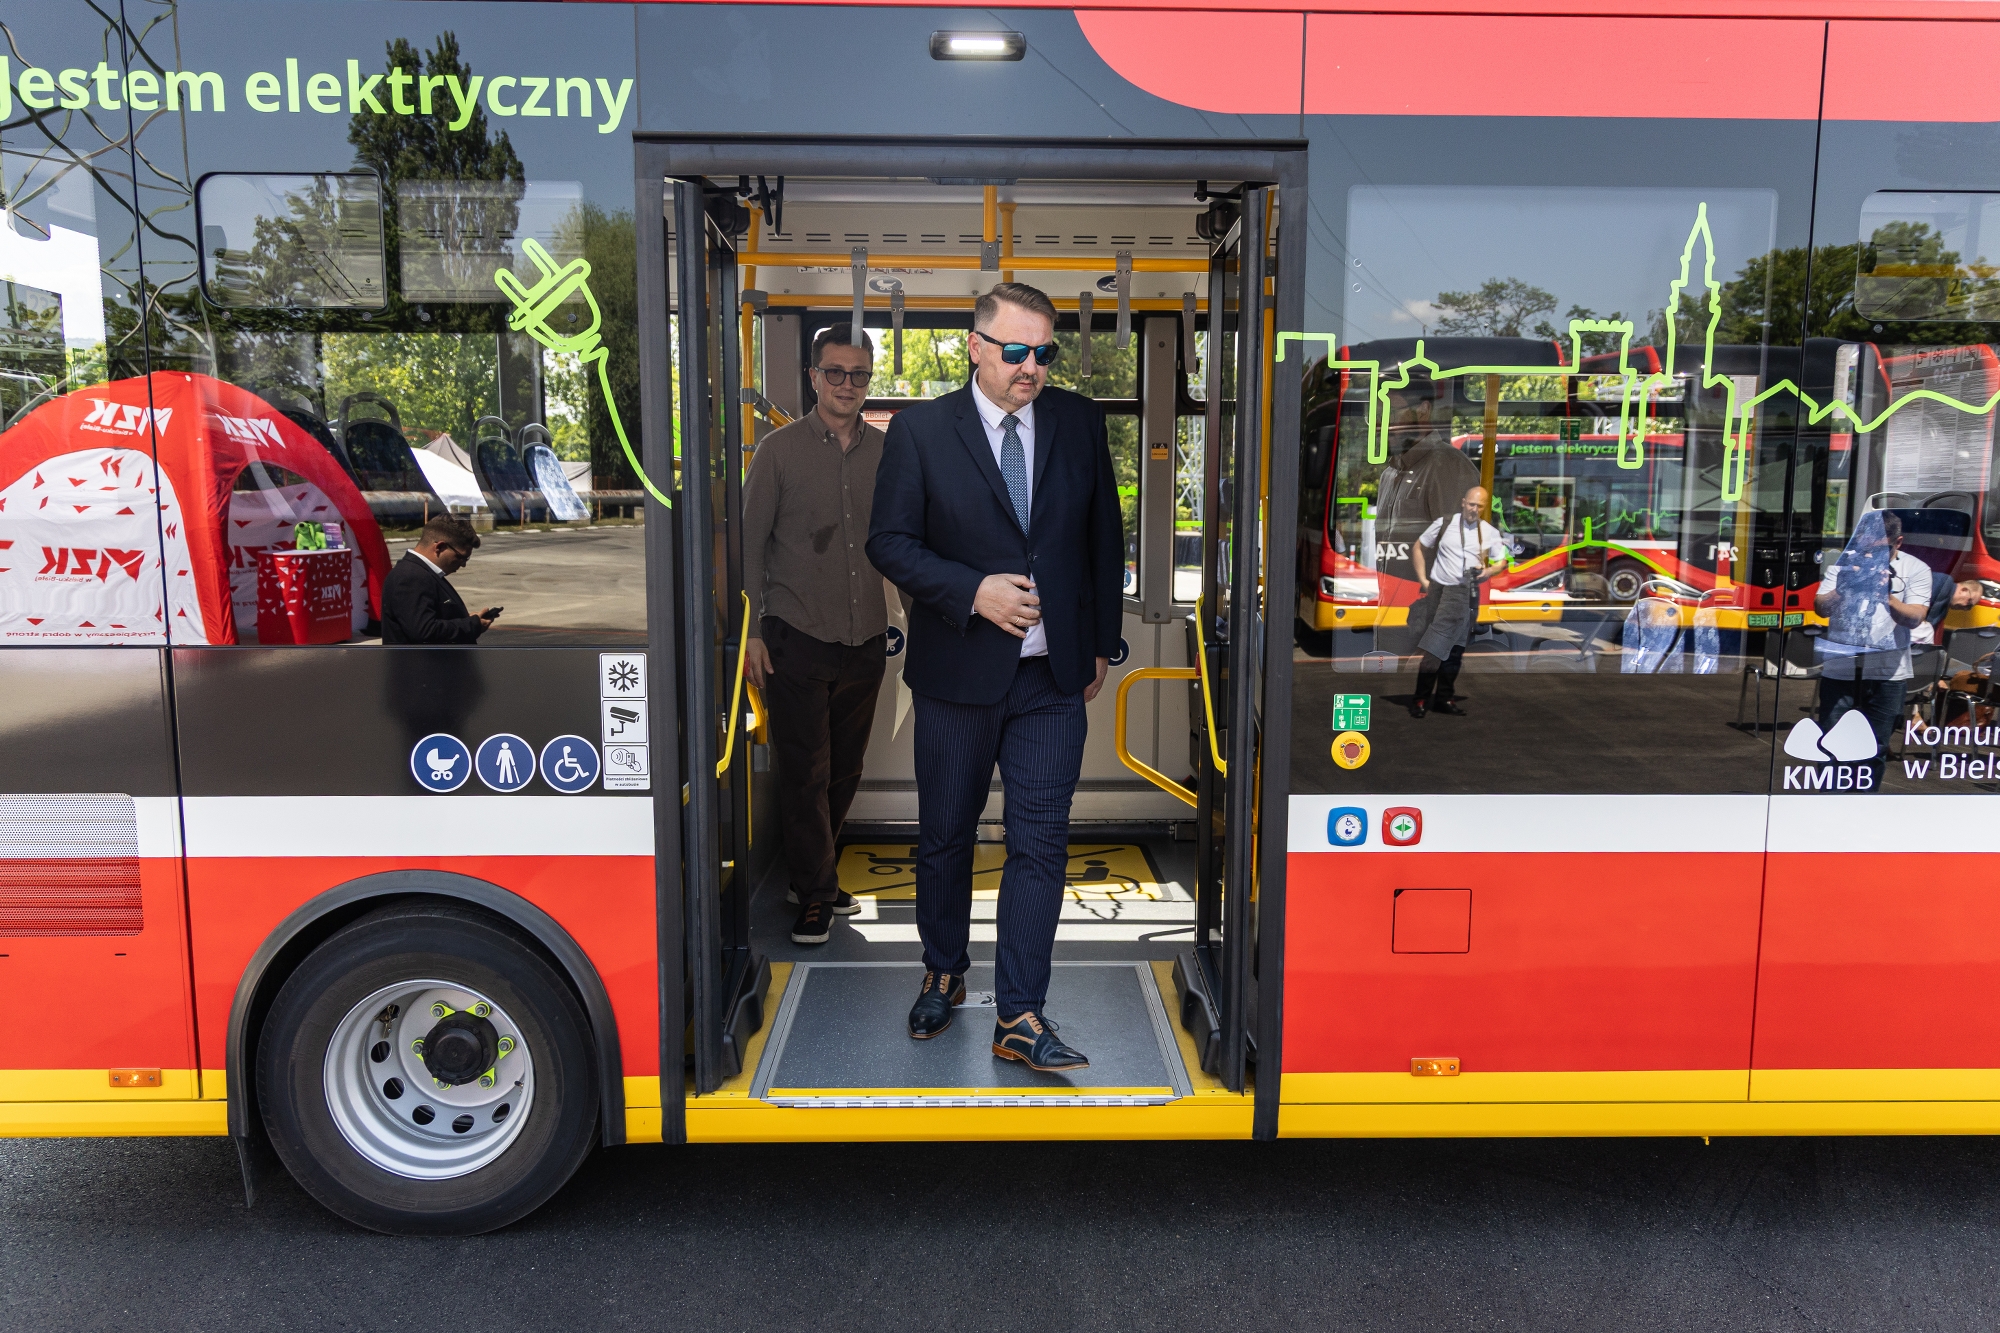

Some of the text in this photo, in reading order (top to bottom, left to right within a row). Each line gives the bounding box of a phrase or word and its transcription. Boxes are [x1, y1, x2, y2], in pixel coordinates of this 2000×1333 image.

[0, 55, 635, 133] Jestem elektryczny
[1509, 443, 1553, 456] Jestem
[1783, 765, 1873, 790] KMBB
[1903, 759, 1930, 779] w
